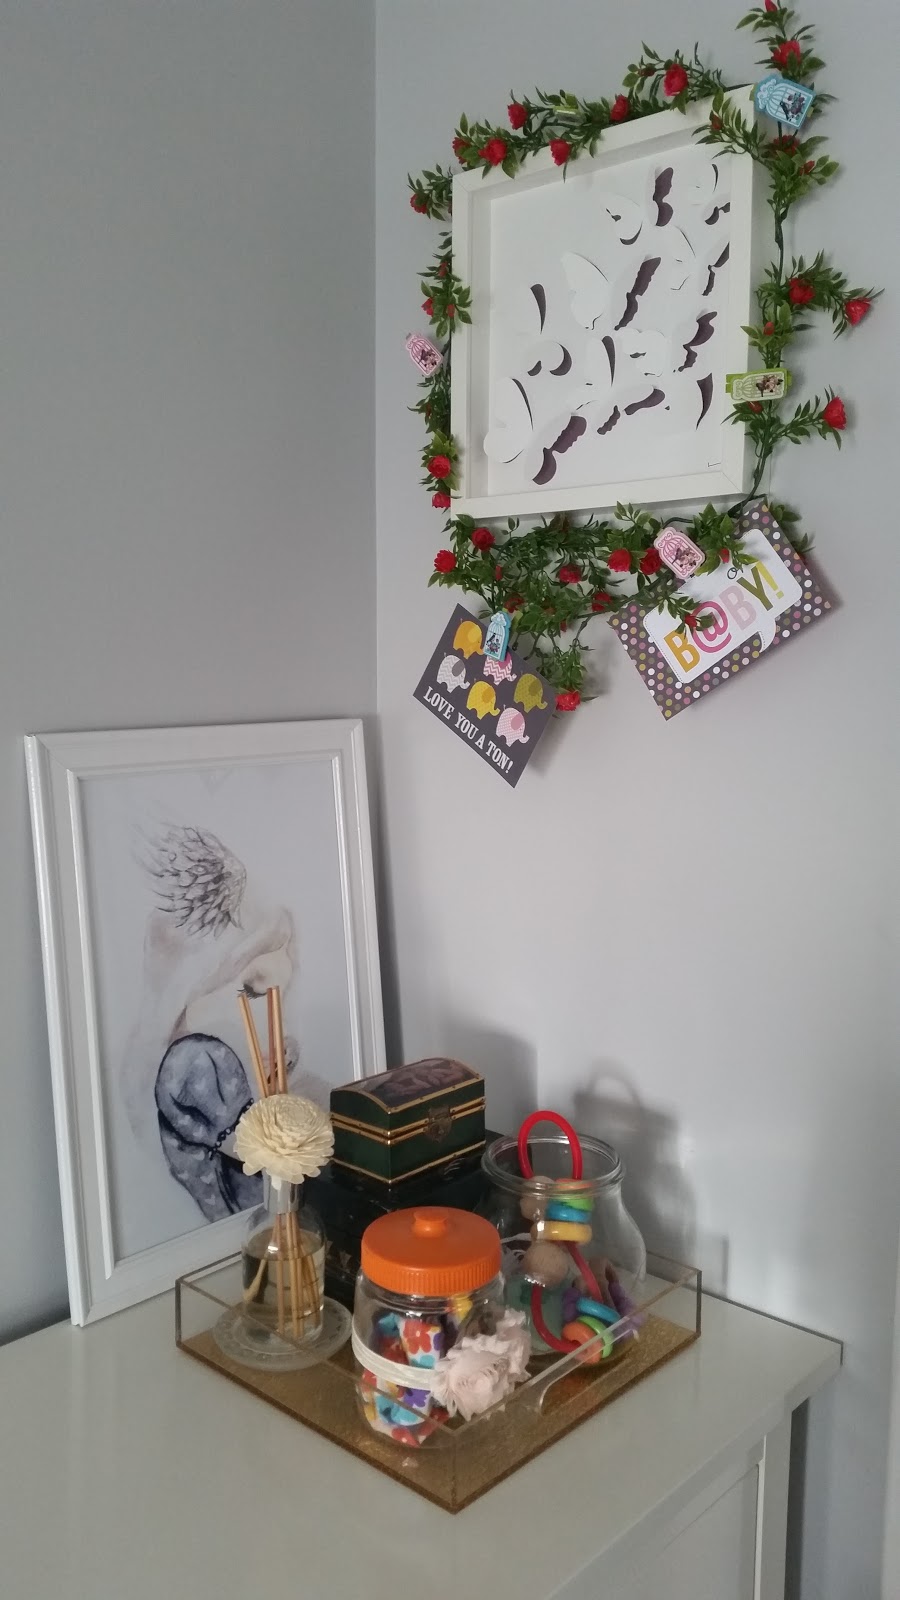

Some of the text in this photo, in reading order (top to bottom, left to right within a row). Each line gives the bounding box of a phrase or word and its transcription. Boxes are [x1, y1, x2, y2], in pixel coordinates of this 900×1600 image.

[663, 561, 784, 673] B@BY!
[423, 686, 513, 773] LOVE YOU A TON!
